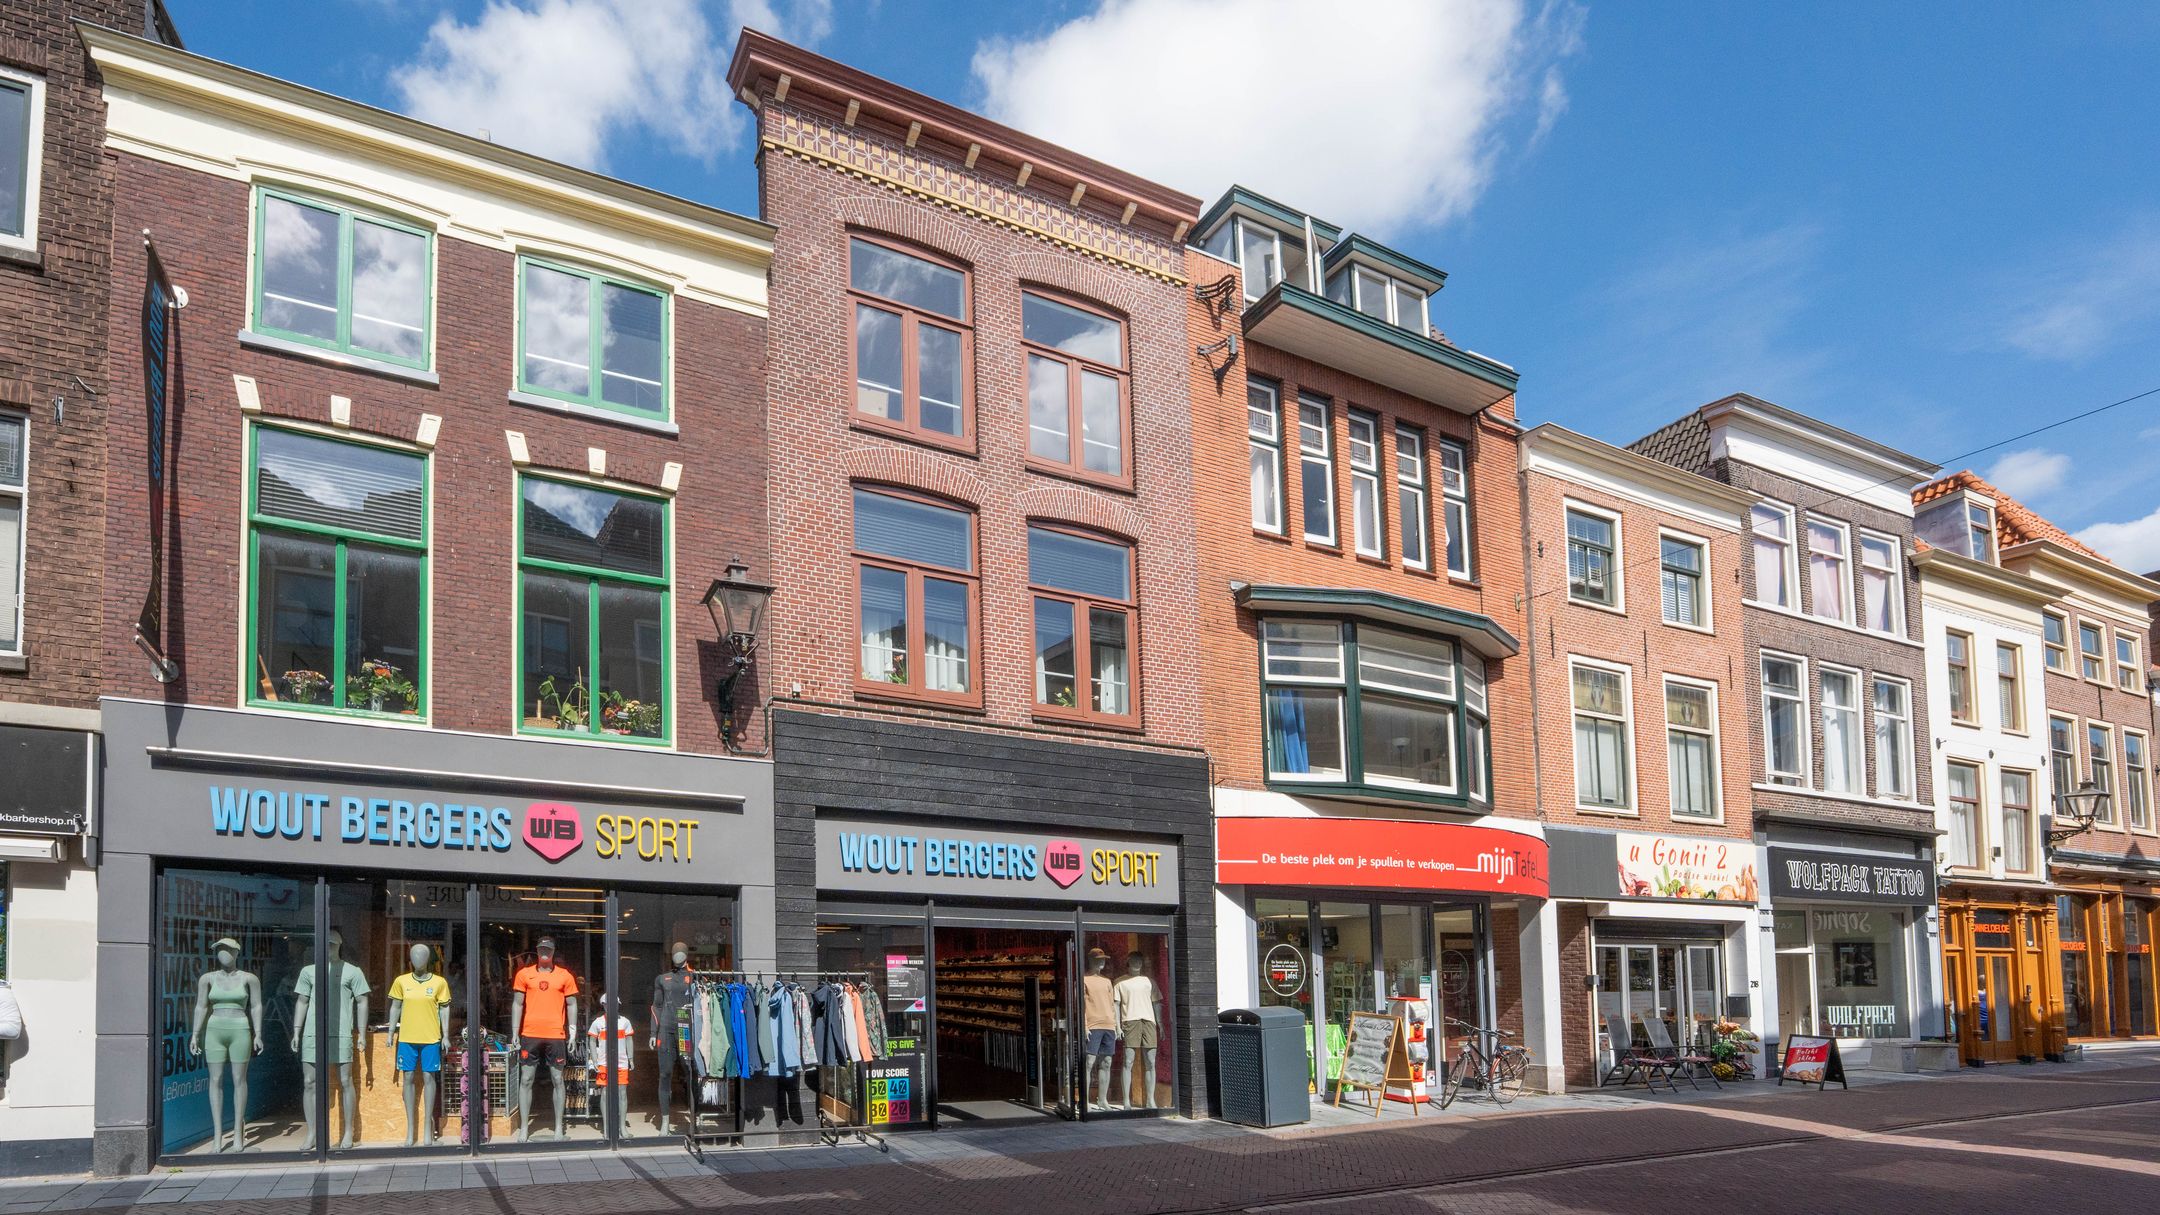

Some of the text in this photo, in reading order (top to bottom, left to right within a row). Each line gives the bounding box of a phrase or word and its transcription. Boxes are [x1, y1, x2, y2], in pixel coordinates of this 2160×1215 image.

[210, 786, 699, 861] WOUT BERGERS WB SPORT
[839, 832, 1161, 886] WOUT BERGERS WB SPORT
[1262, 853, 1455, 872] De beste plek om je spullen te verkopen
[1652, 838, 1708, 867] Gonii
[1717, 844, 1727, 870] 2
[1786, 860, 1925, 896] WOLFPACK TATTOO
[176, 877, 240, 921] TREATED
[163, 915, 201, 954] LIKE
[1827, 1005, 1896, 1026] WOLFPACK
[899, 1040, 915, 1049] GIVE
[885, 1068, 910, 1078] SCORE
[162, 1077, 208, 1102] LeBron Jam
